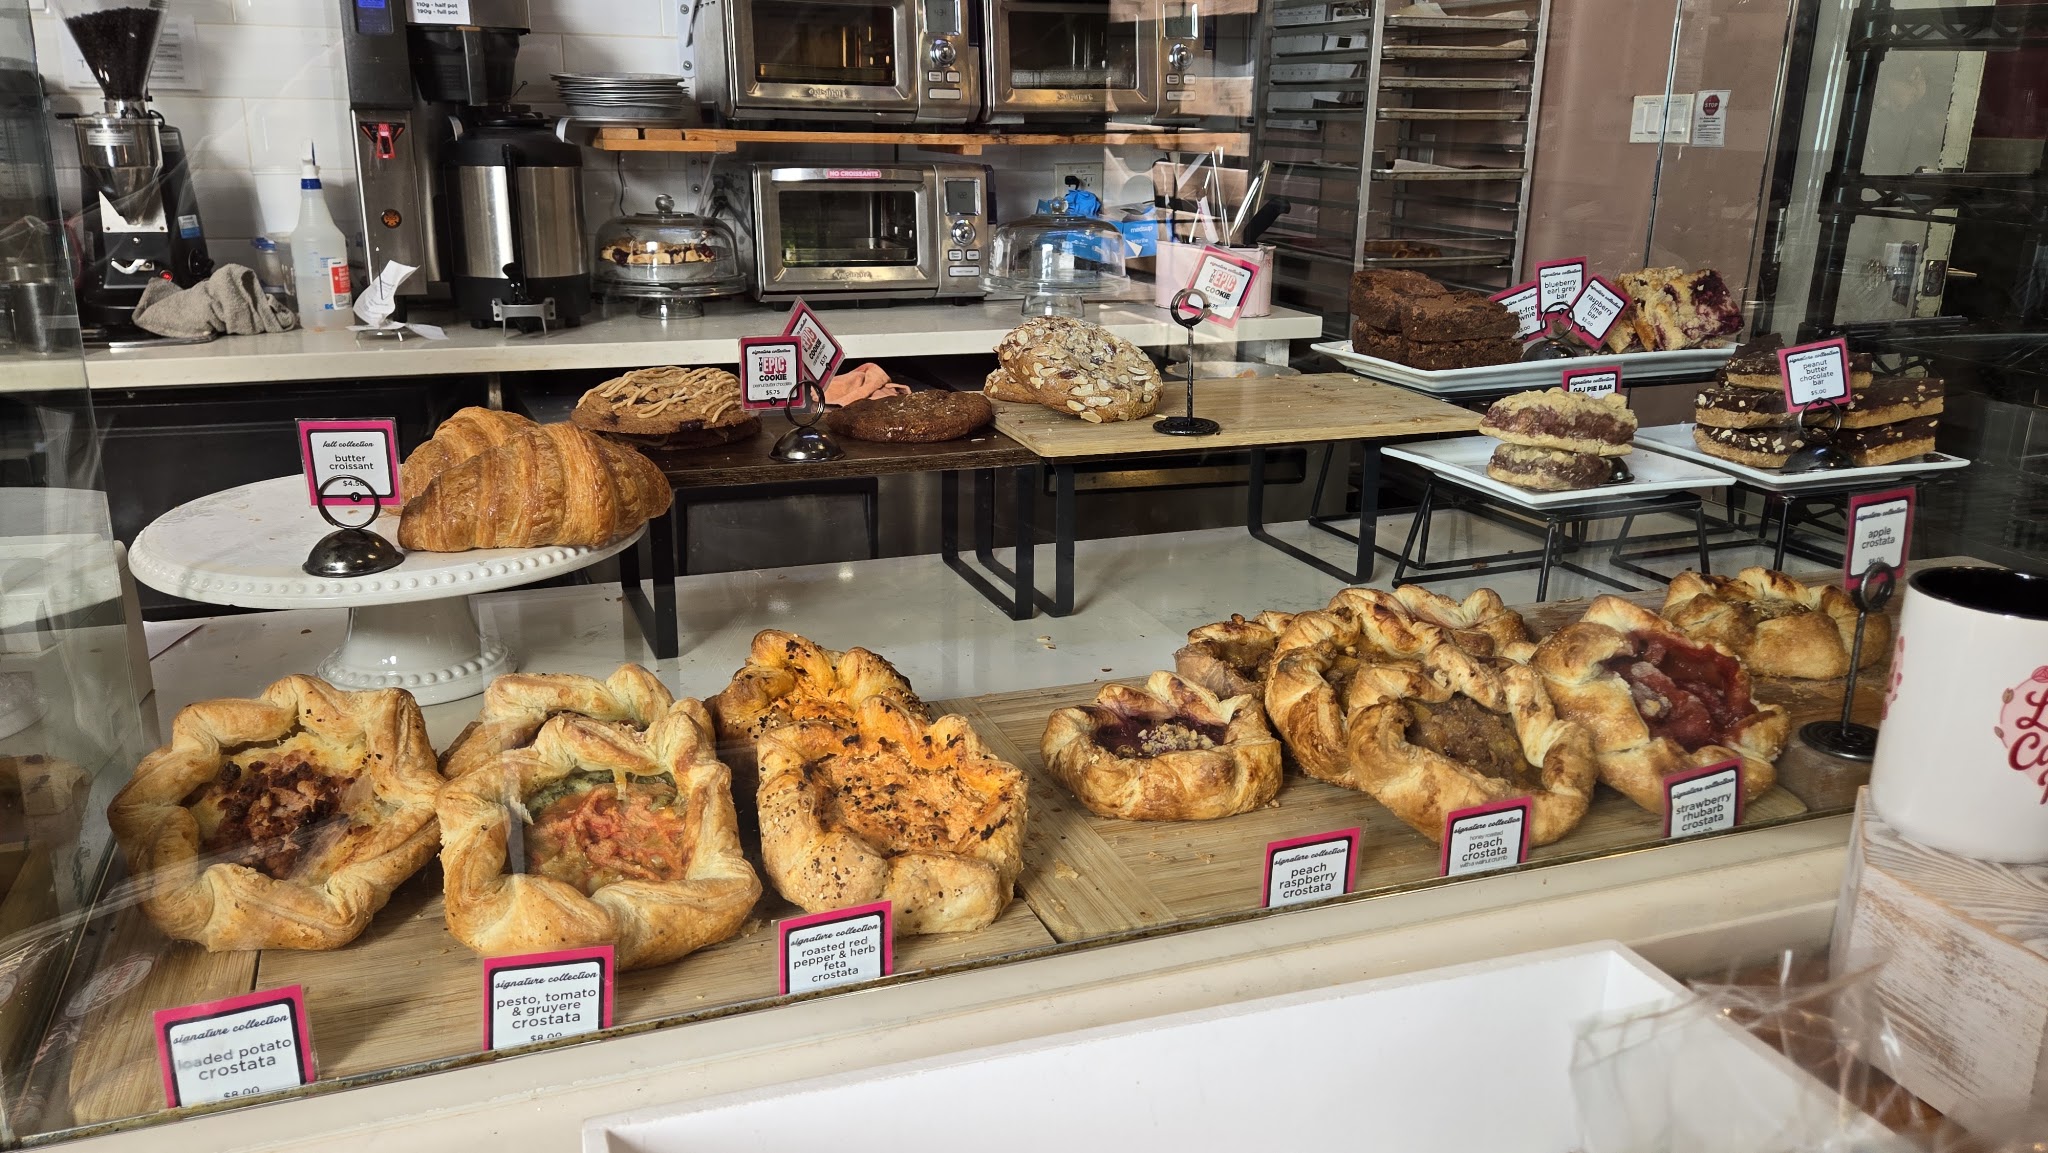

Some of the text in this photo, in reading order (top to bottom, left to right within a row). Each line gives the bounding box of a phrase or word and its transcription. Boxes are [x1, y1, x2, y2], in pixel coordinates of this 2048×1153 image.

[1213, 270, 1237, 292] EPIC
[1544, 279, 1576, 289] blueberry
[1205, 286, 1231, 300] COOKIE
[1586, 294, 1613, 316] raspberry
[1589, 304, 1602, 315] lime
[1587, 310, 1598, 320] bar
[809, 338, 822, 359] COOKIE
[763, 356, 787, 374] EPIC
[1803, 360, 1827, 370] peanut
[1806, 366, 1828, 374] butter
[1800, 372, 1834, 382] chocolate
[329, 462, 374, 470] croissant
[1868, 527, 1892, 539] apple
[1862, 536, 1895, 549] crostata
[1676, 793, 1731, 815] strawberry
[1683, 804, 1724, 822] rhubarb
[1454, 816, 1520, 834] signature collection
[1681, 814, 1724, 831] crostata
[1469, 837, 1502, 852] peach
[1274, 847, 1346, 866] signature collection
[1462, 846, 1507, 862] crostata
[1291, 862, 1326, 879] peach
[1279, 872, 1337, 889] raspberry
[1283, 882, 1332, 898] crostata
[791, 923, 878, 947] signature collection
[802, 936, 868, 957] roasted red
[794, 944, 876, 970] pepper & herb
[824, 960, 846, 971] feta
[495, 971, 598, 989] signature collection
[812, 967, 858, 982] crostata
[496, 989, 596, 1010] pesto, tomato
[512, 1001, 581, 1016] & gruyere
[512, 1012, 581, 1029] crostata
[173, 1014, 289, 1045] signature collection
[530, 1032, 562, 1041] $800
[177, 1039, 292, 1070] loaded potato
[199, 1055, 276, 1081] crostata
[223, 1086, 260, 1098] $800
